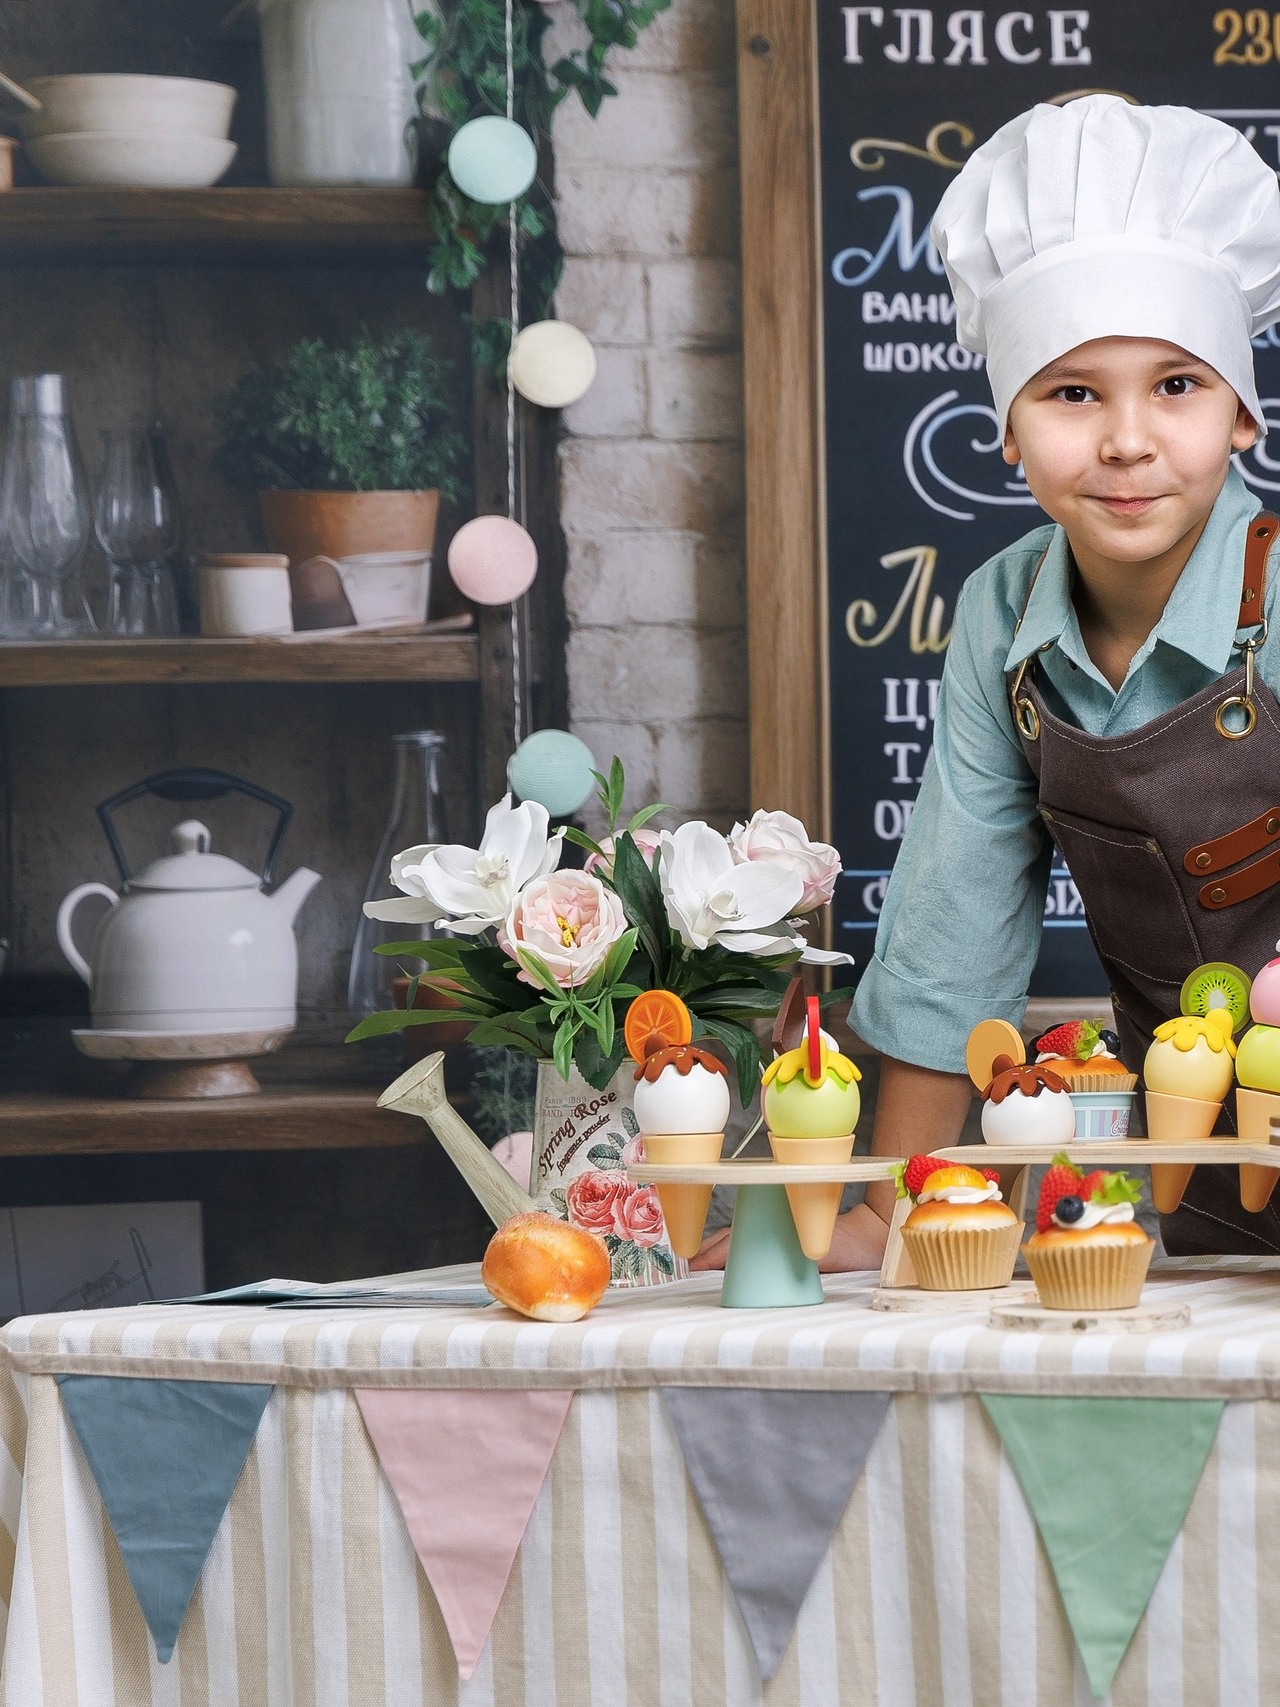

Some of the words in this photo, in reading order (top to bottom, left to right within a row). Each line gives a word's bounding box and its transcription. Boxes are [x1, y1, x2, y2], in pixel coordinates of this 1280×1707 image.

[842, 7, 1092, 65] ГЛЯСЕ
[538, 1117, 576, 1177] Spring
[574, 1091, 617, 1121] Rose
